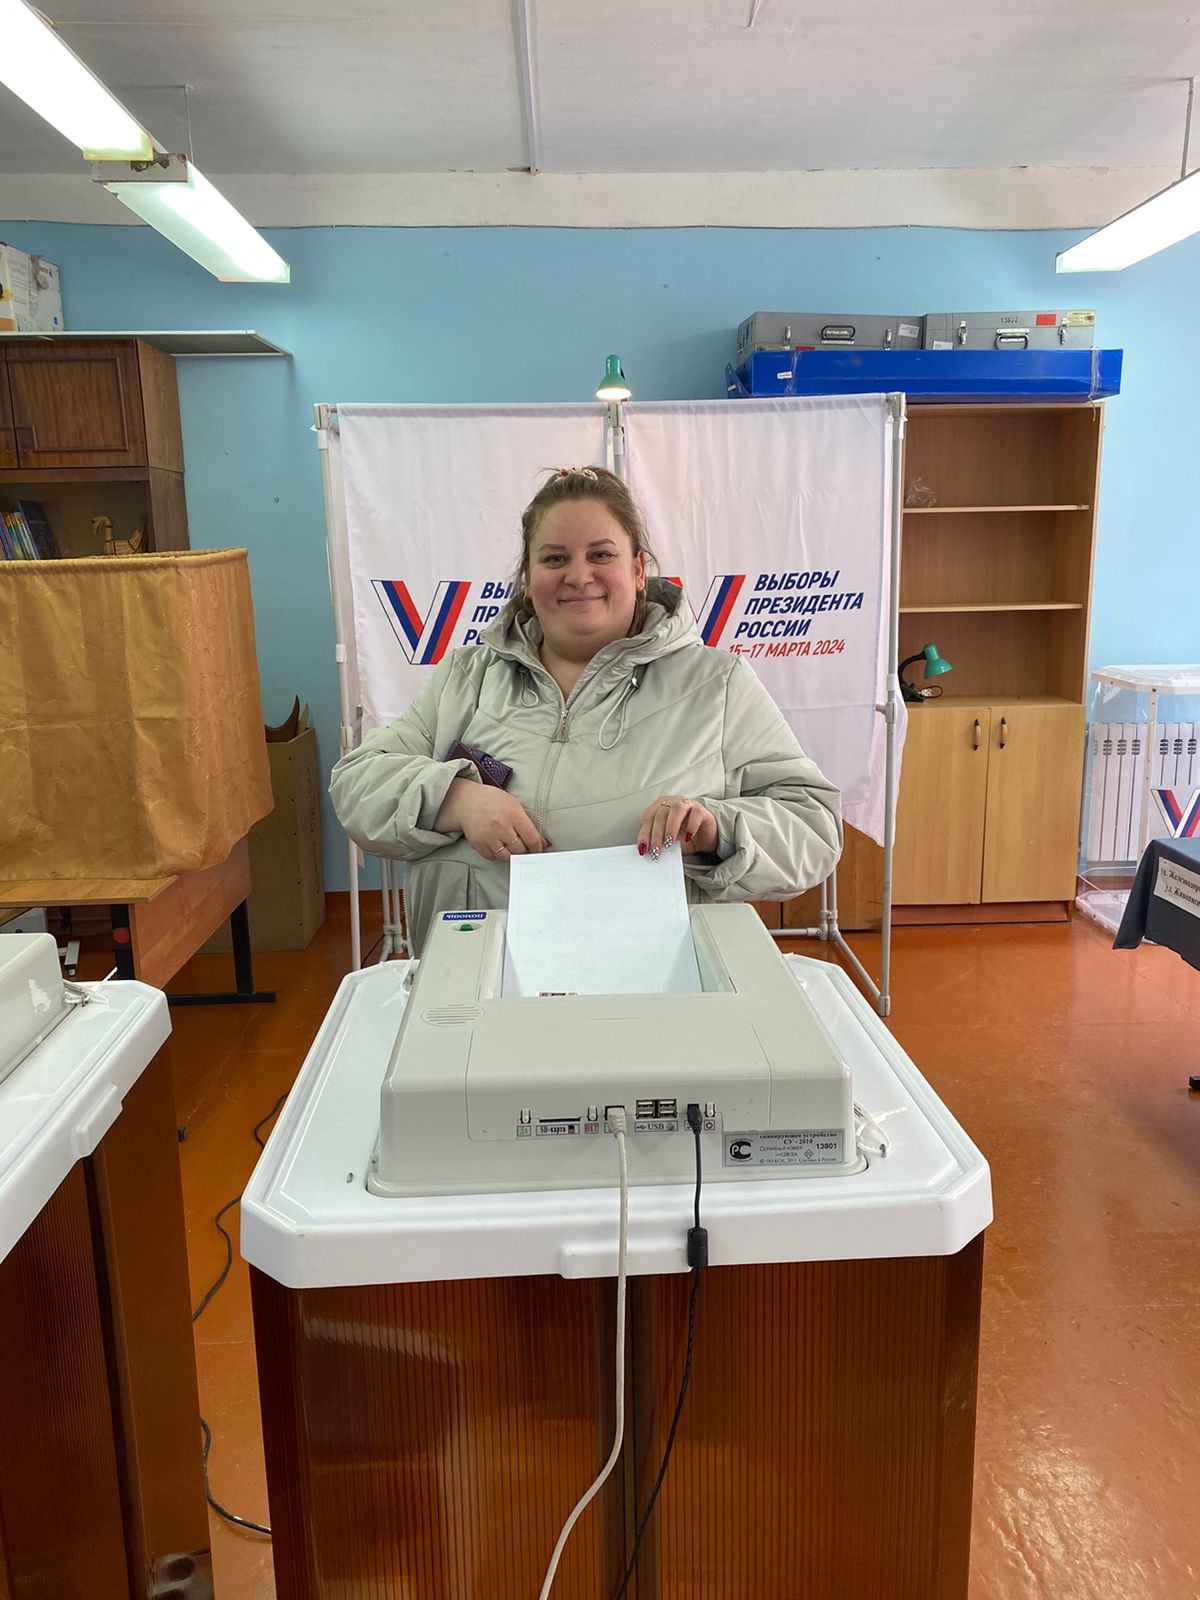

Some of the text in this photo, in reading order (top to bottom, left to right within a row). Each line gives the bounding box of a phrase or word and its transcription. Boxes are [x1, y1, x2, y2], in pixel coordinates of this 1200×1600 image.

[754, 570, 840, 591] ВЫБОРЫ
[744, 592, 864, 615] ПРЕЗИДЕНТА
[472, 606, 503, 622] ПР
[734, 619, 812, 639] РОССИИ
[765, 642, 811, 657] МАРТА
[812, 639, 846, 655] 2024
[816, 1142, 837, 1150] 13801
